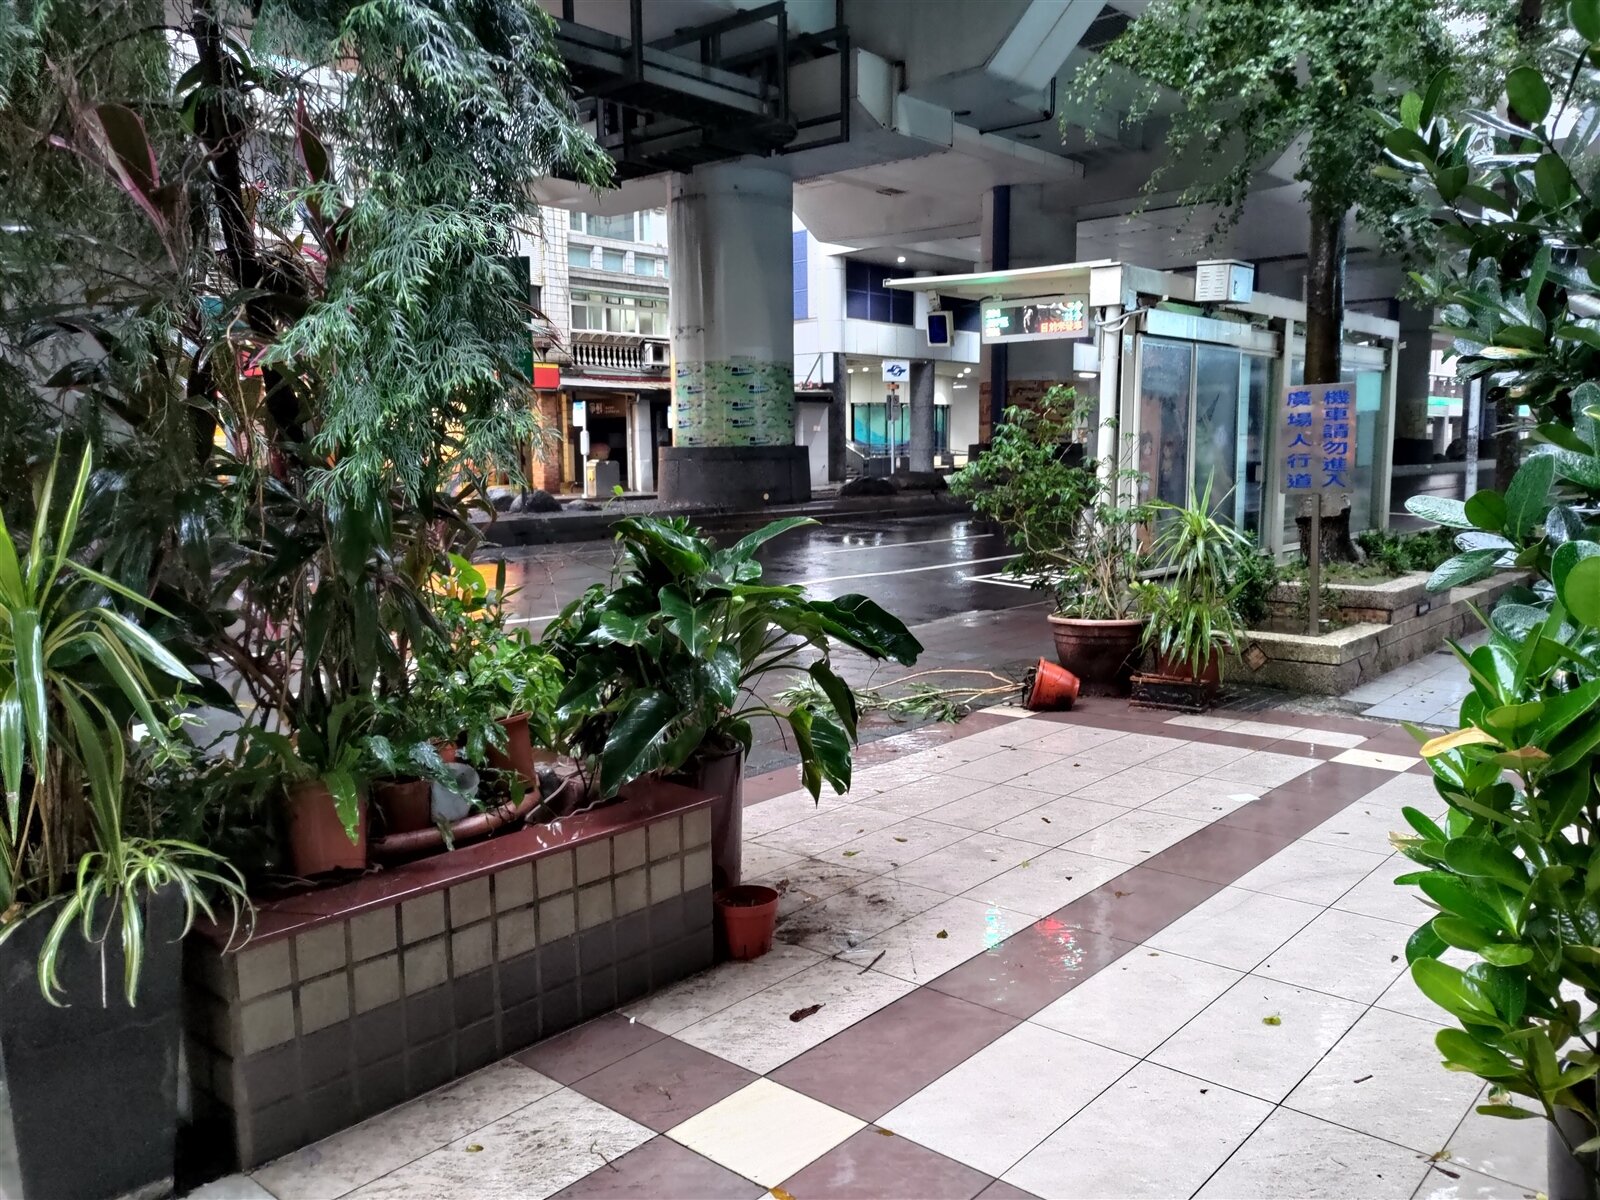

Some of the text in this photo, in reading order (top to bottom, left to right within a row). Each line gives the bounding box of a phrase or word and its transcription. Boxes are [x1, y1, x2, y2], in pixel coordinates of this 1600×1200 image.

[1287, 391, 1312, 489] 廣場人行道
[1322, 389, 1350, 488] 機車請勿進入
